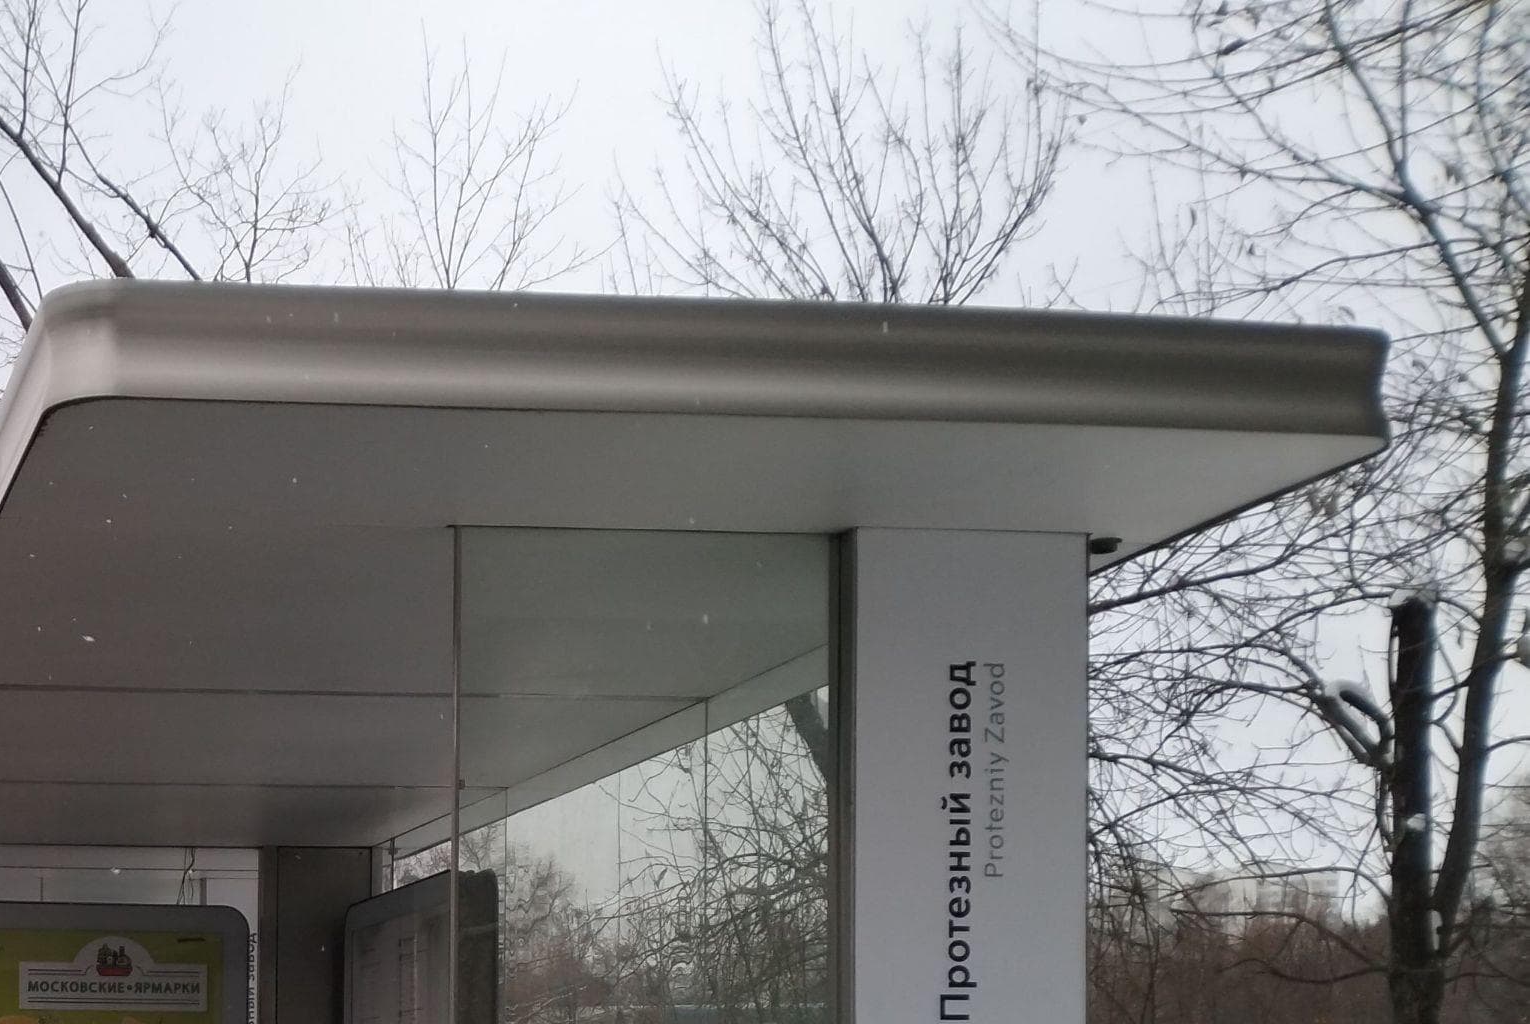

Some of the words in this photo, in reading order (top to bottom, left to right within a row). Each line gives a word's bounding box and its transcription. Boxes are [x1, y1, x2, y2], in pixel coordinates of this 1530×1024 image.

[949, 660, 977, 779] завод
[983, 662, 1005, 743] Zavod
[984, 751, 1009, 877] Protezniy
[940, 793, 977, 1021] Протезный
[27, 980, 125, 993] МОСКОВСКИЕ
[134, 981, 201, 994] ЯРМАРКИ
